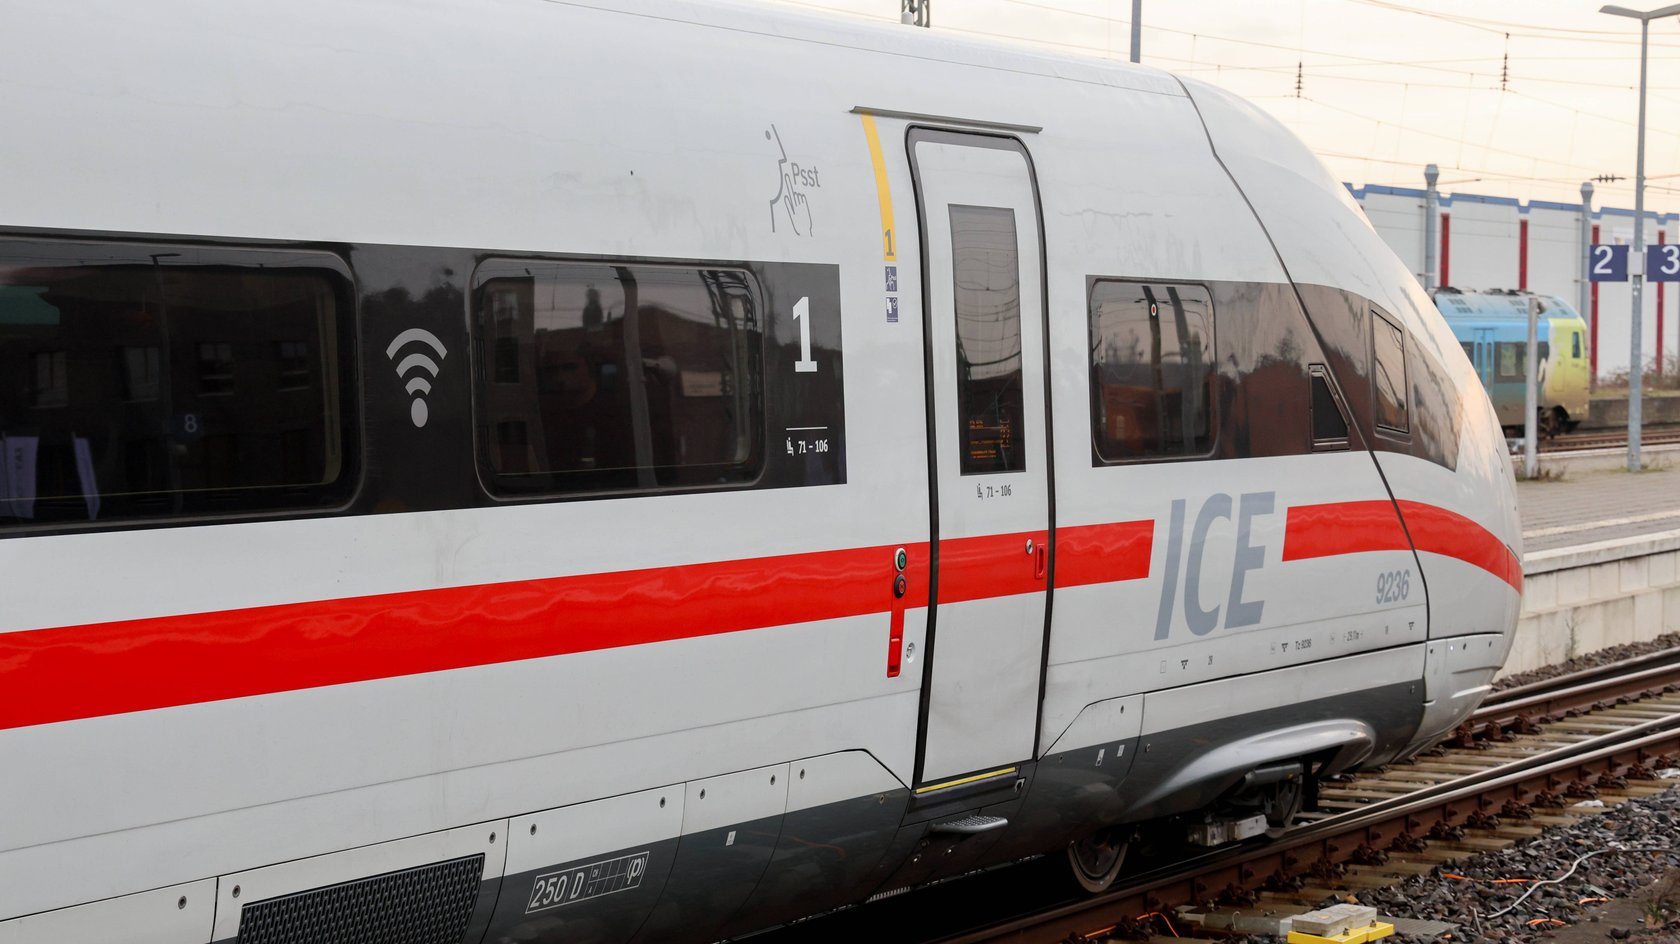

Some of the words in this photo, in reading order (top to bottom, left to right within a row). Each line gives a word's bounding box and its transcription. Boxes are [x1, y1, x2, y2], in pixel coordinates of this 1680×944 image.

[791, 162, 821, 188] Psst
[886, 229, 895, 256] 1
[1593, 245, 1613, 274] 2
[1660, 245, 1680, 275] 3
[792, 296, 818, 373] 1
[798, 440, 807, 454] 71
[815, 439, 829, 453] 106
[986, 486, 994, 498] 71
[1000, 484, 1012, 497] 106
[1154, 491, 1276, 641] ICE
[1376, 569, 1411, 604] 9236
[530, 875, 567, 908] 250
[569, 873, 585, 899] D
